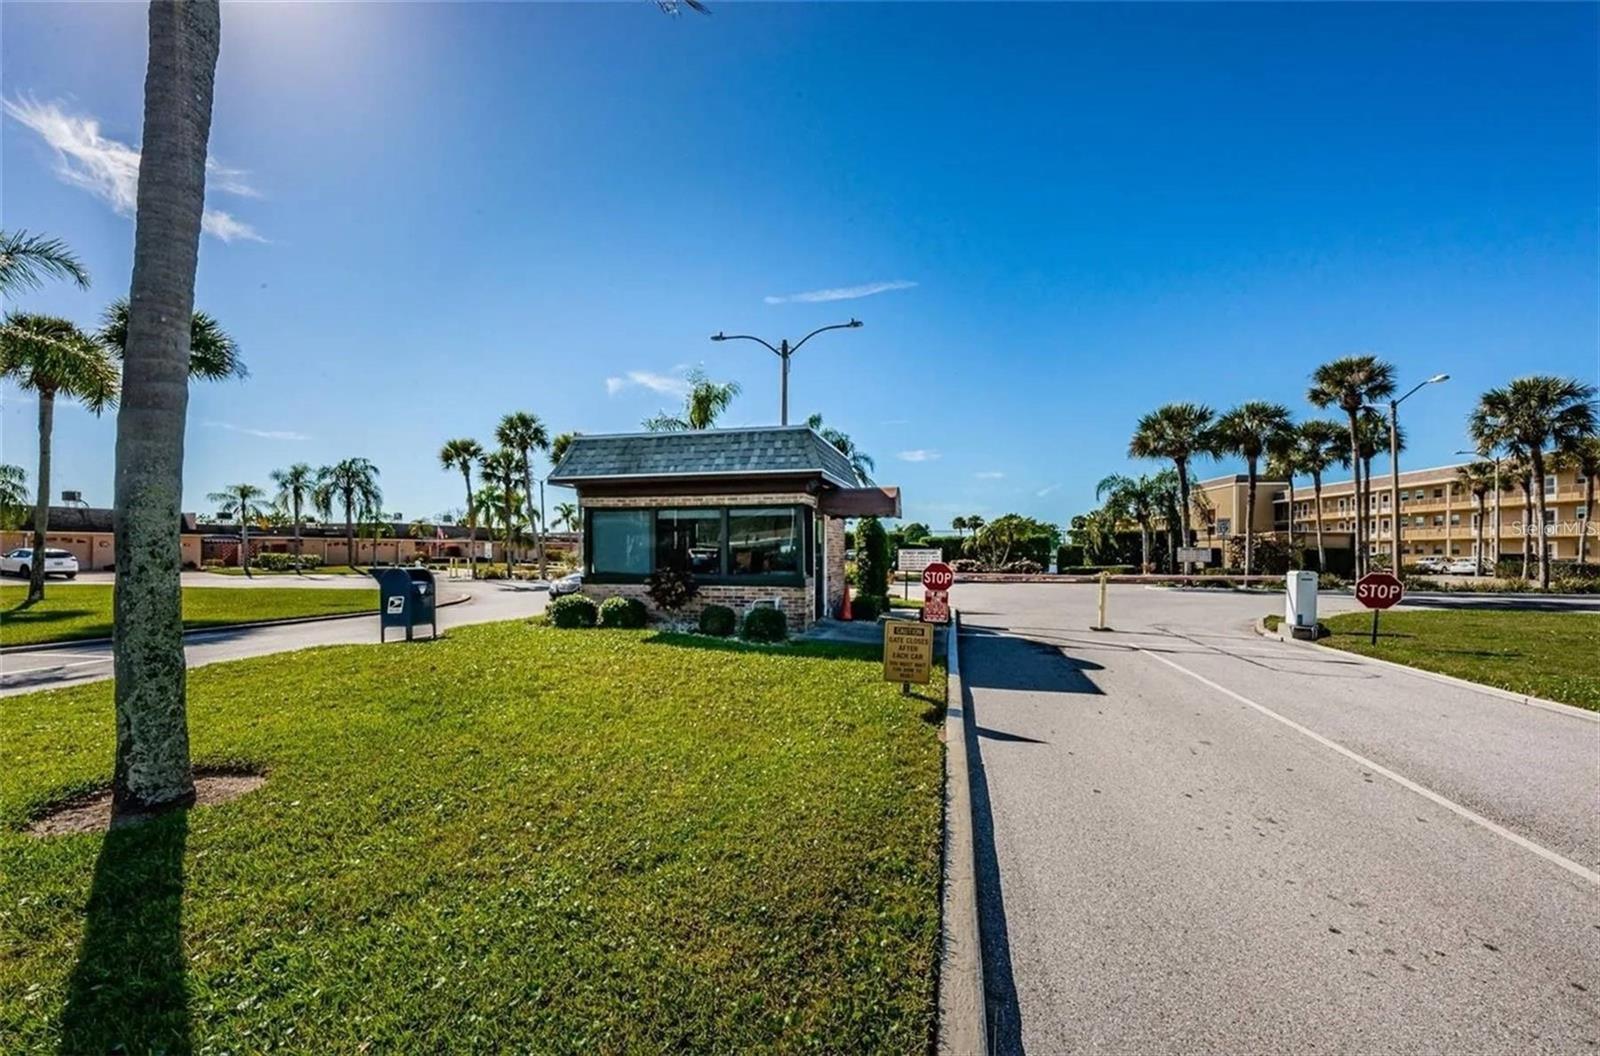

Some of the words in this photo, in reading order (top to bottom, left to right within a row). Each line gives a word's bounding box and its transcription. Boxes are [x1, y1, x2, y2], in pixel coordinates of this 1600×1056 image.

[924, 571, 952, 584] STOP
[1358, 583, 1400, 599] STOP
[895, 627, 923, 635] CAUTION
[906, 637, 929, 645] CLOSES
